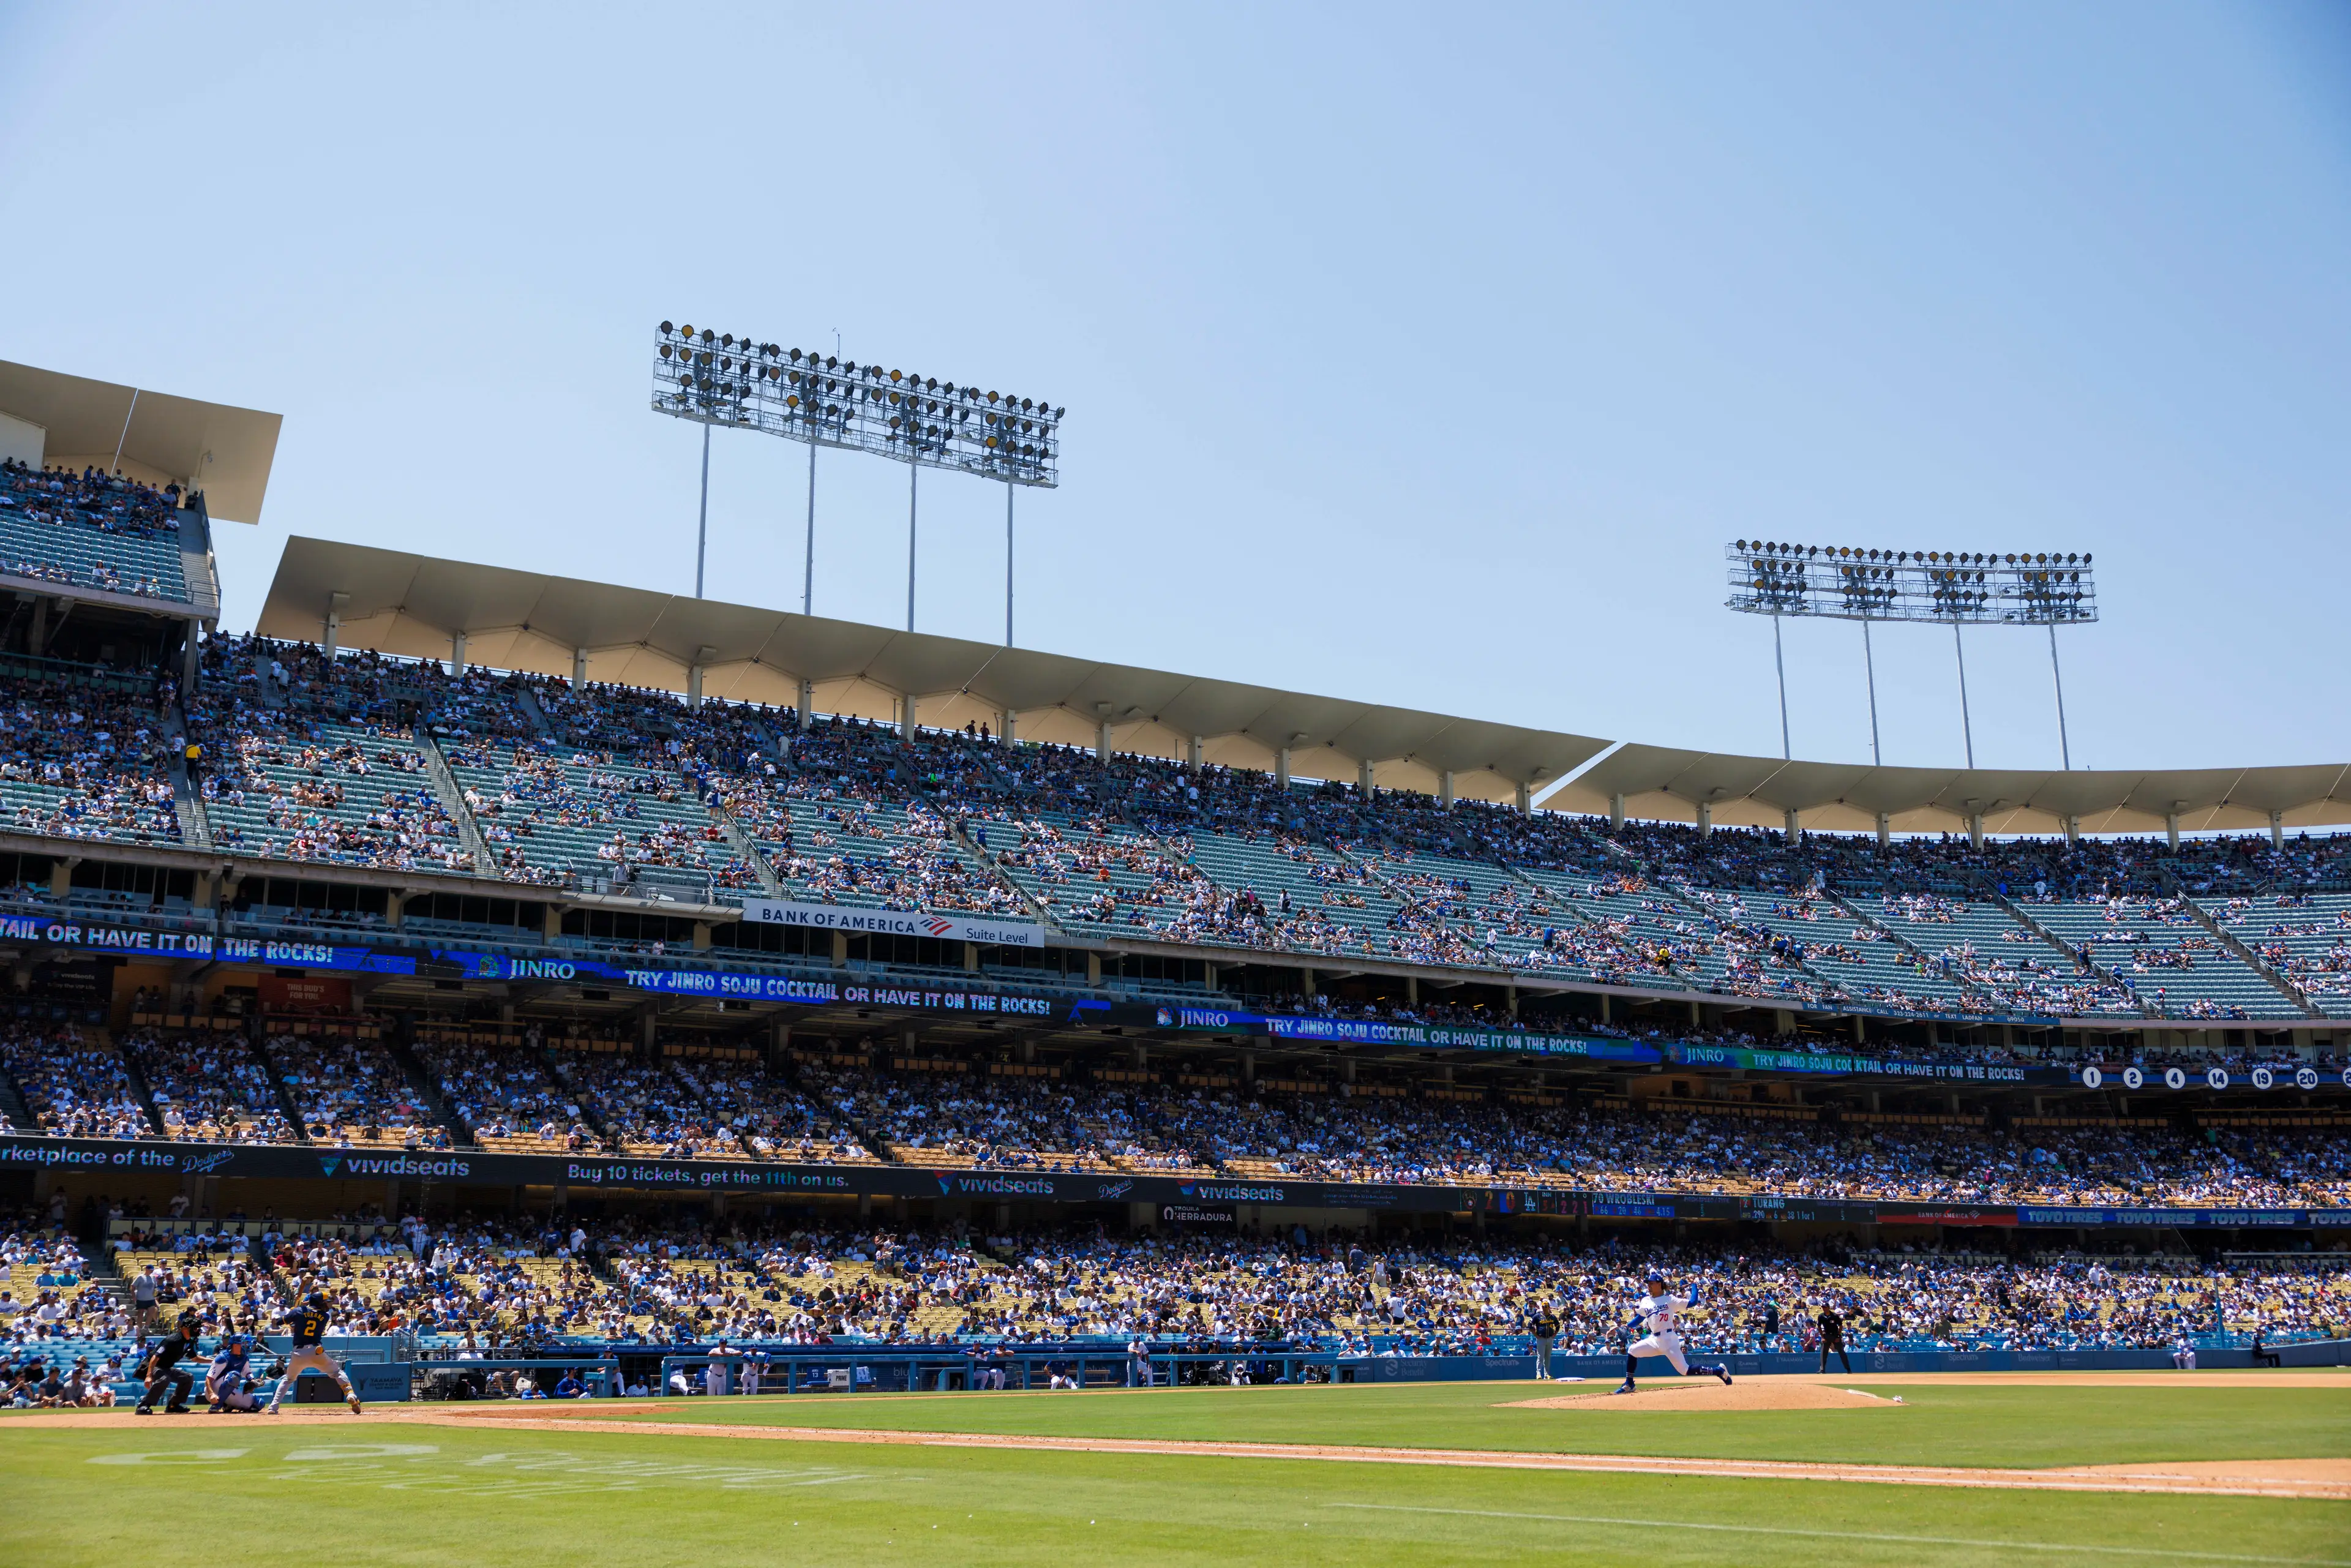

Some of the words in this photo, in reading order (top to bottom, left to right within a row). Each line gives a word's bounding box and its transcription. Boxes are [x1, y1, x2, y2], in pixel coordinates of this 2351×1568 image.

[762, 909, 809, 924] BANK
[814, 913, 835, 926] OF
[840, 915, 915, 933] AMERICA
[967, 928, 995, 940] Suite
[999, 931, 1027, 943] Level
[47, 925, 81, 943] OR
[88, 928, 151, 948] HAVE
[157, 934, 180, 951] IT
[185, 935, 212, 953] ON
[224, 937, 260, 957] THE
[266, 941, 333, 962] ROCKS!
[508, 959, 576, 980] JINRO
[304, 984, 324, 992] BUD'S
[625, 970, 664, 987] TRY
[667, 972, 714, 991] JINRO
[721, 976, 760, 994] SOJU
[767, 979, 839, 1000] COCKTAIL
[845, 986, 869, 1002] OR
[874, 989, 920, 1006] HAVE
[925, 992, 941, 1007] IT
[945, 993, 965, 1009] ON
[970, 994, 997, 1011] THE
[1001, 997, 1050, 1015] ROCKS!
[290, 991, 303, 999] FOR
[1179, 1010, 1229, 1028] JINRO
[1265, 1018, 1294, 1032] TRY
[1297, 1019, 1333, 1036] JINRO
[1337, 1022, 1367, 1038] SOJU
[1371, 1025, 1427, 1042] COCKTAIL
[1430, 1030, 1449, 1045] OR
[1453, 1032, 1487, 1046] HAVE
[1491, 1035, 1503, 1048] IT
[1506, 1035, 1521, 1049] ON
[1525, 1036, 1545, 1051] THE
[1549, 1038, 1587, 1054] ROCKS!
[1687, 1048, 1724, 1063] JINRO
[1753, 1054, 1774, 1066] TRY
[1777, 1055, 1805, 1068] JINRO
[1809, 1057, 1832, 1070] SOJU
[1835, 1059, 1883, 1073] COCKTAIL
[1886, 1063, 1901, 1074] OR
[1904, 1065, 1933, 1076] HAVE
[1936, 1066, 1947, 1078] IT
[1949, 1066, 1963, 1078] ON
[1966, 1067, 1985, 1079] THE
[1988, 1067, 2024, 1080] ROCKS!
[2090, 1071, 2094, 1084] 1
[2129, 1071, 2137, 1084] 2
[2170, 1072, 2179, 1084] 4
[2212, 1072, 2225, 1084] 14
[2256, 1072, 2268, 1084] 19
[2299, 1072, 2315, 1084] 20
[0, 1144, 107, 1166] rketplace
[113, 1149, 135, 1165] of
[140, 1150, 174, 1166] the
[182, 1147, 234, 1173] Dodgers
[347, 1155, 470, 1176] vividseats
[568, 1164, 602, 1183] Buy
[607, 1166, 626, 1180] 10
[632, 1166, 695, 1184] tickets,
[700, 1169, 728, 1186] get
[733, 1169, 760, 1184] the
[766, 1171, 796, 1185] 11th
[801, 1176, 821, 1186] on
[827, 1176, 849, 1187] us.
[958, 1176, 1054, 1194] vividseats
[1098, 1178, 1133, 1199] Dodgers
[1199, 1184, 1284, 1201] vividseats
[1485, 1191, 1493, 1209] 2
[1506, 1191, 1515, 1210] 0
[1593, 1193, 1603, 1204] 70
[1606, 1193, 1655, 1206] WROBLESKI
[1744, 1198, 1748, 1207] 2
[1752, 1198, 1785, 1209] TURANG
[1560, 1200, 1567, 1214] 2
[1572, 1200, 1578, 1214] 2
[1583, 1201, 1588, 1214] 1
[1656, 1207, 1670, 1216] 4.15
[1174, 1212, 1232, 1221] HERRADURA
[1774, 1210, 1777, 1219] 6
[1787, 1211, 1794, 1220] 38
[2028, 1211, 2063, 1223] TOYO
[2064, 1212, 2103, 1223] TIRES
[2115, 1212, 2153, 1224] TOYO
[2154, 1213, 2195, 1224] TIRES
[2209, 1213, 2248, 1224] TOYO
[2251, 1213, 2295, 1224] TIRES
[2309, 1213, 2351, 1224] TOYO
[304, 1312, 324, 1321] TURANG
[1644, 1304, 1669, 1318] Dodgers
[1659, 1313, 1668, 1322] 70
[304, 1320, 317, 1337] 2
[1401, 1359, 1427, 1368] Security
